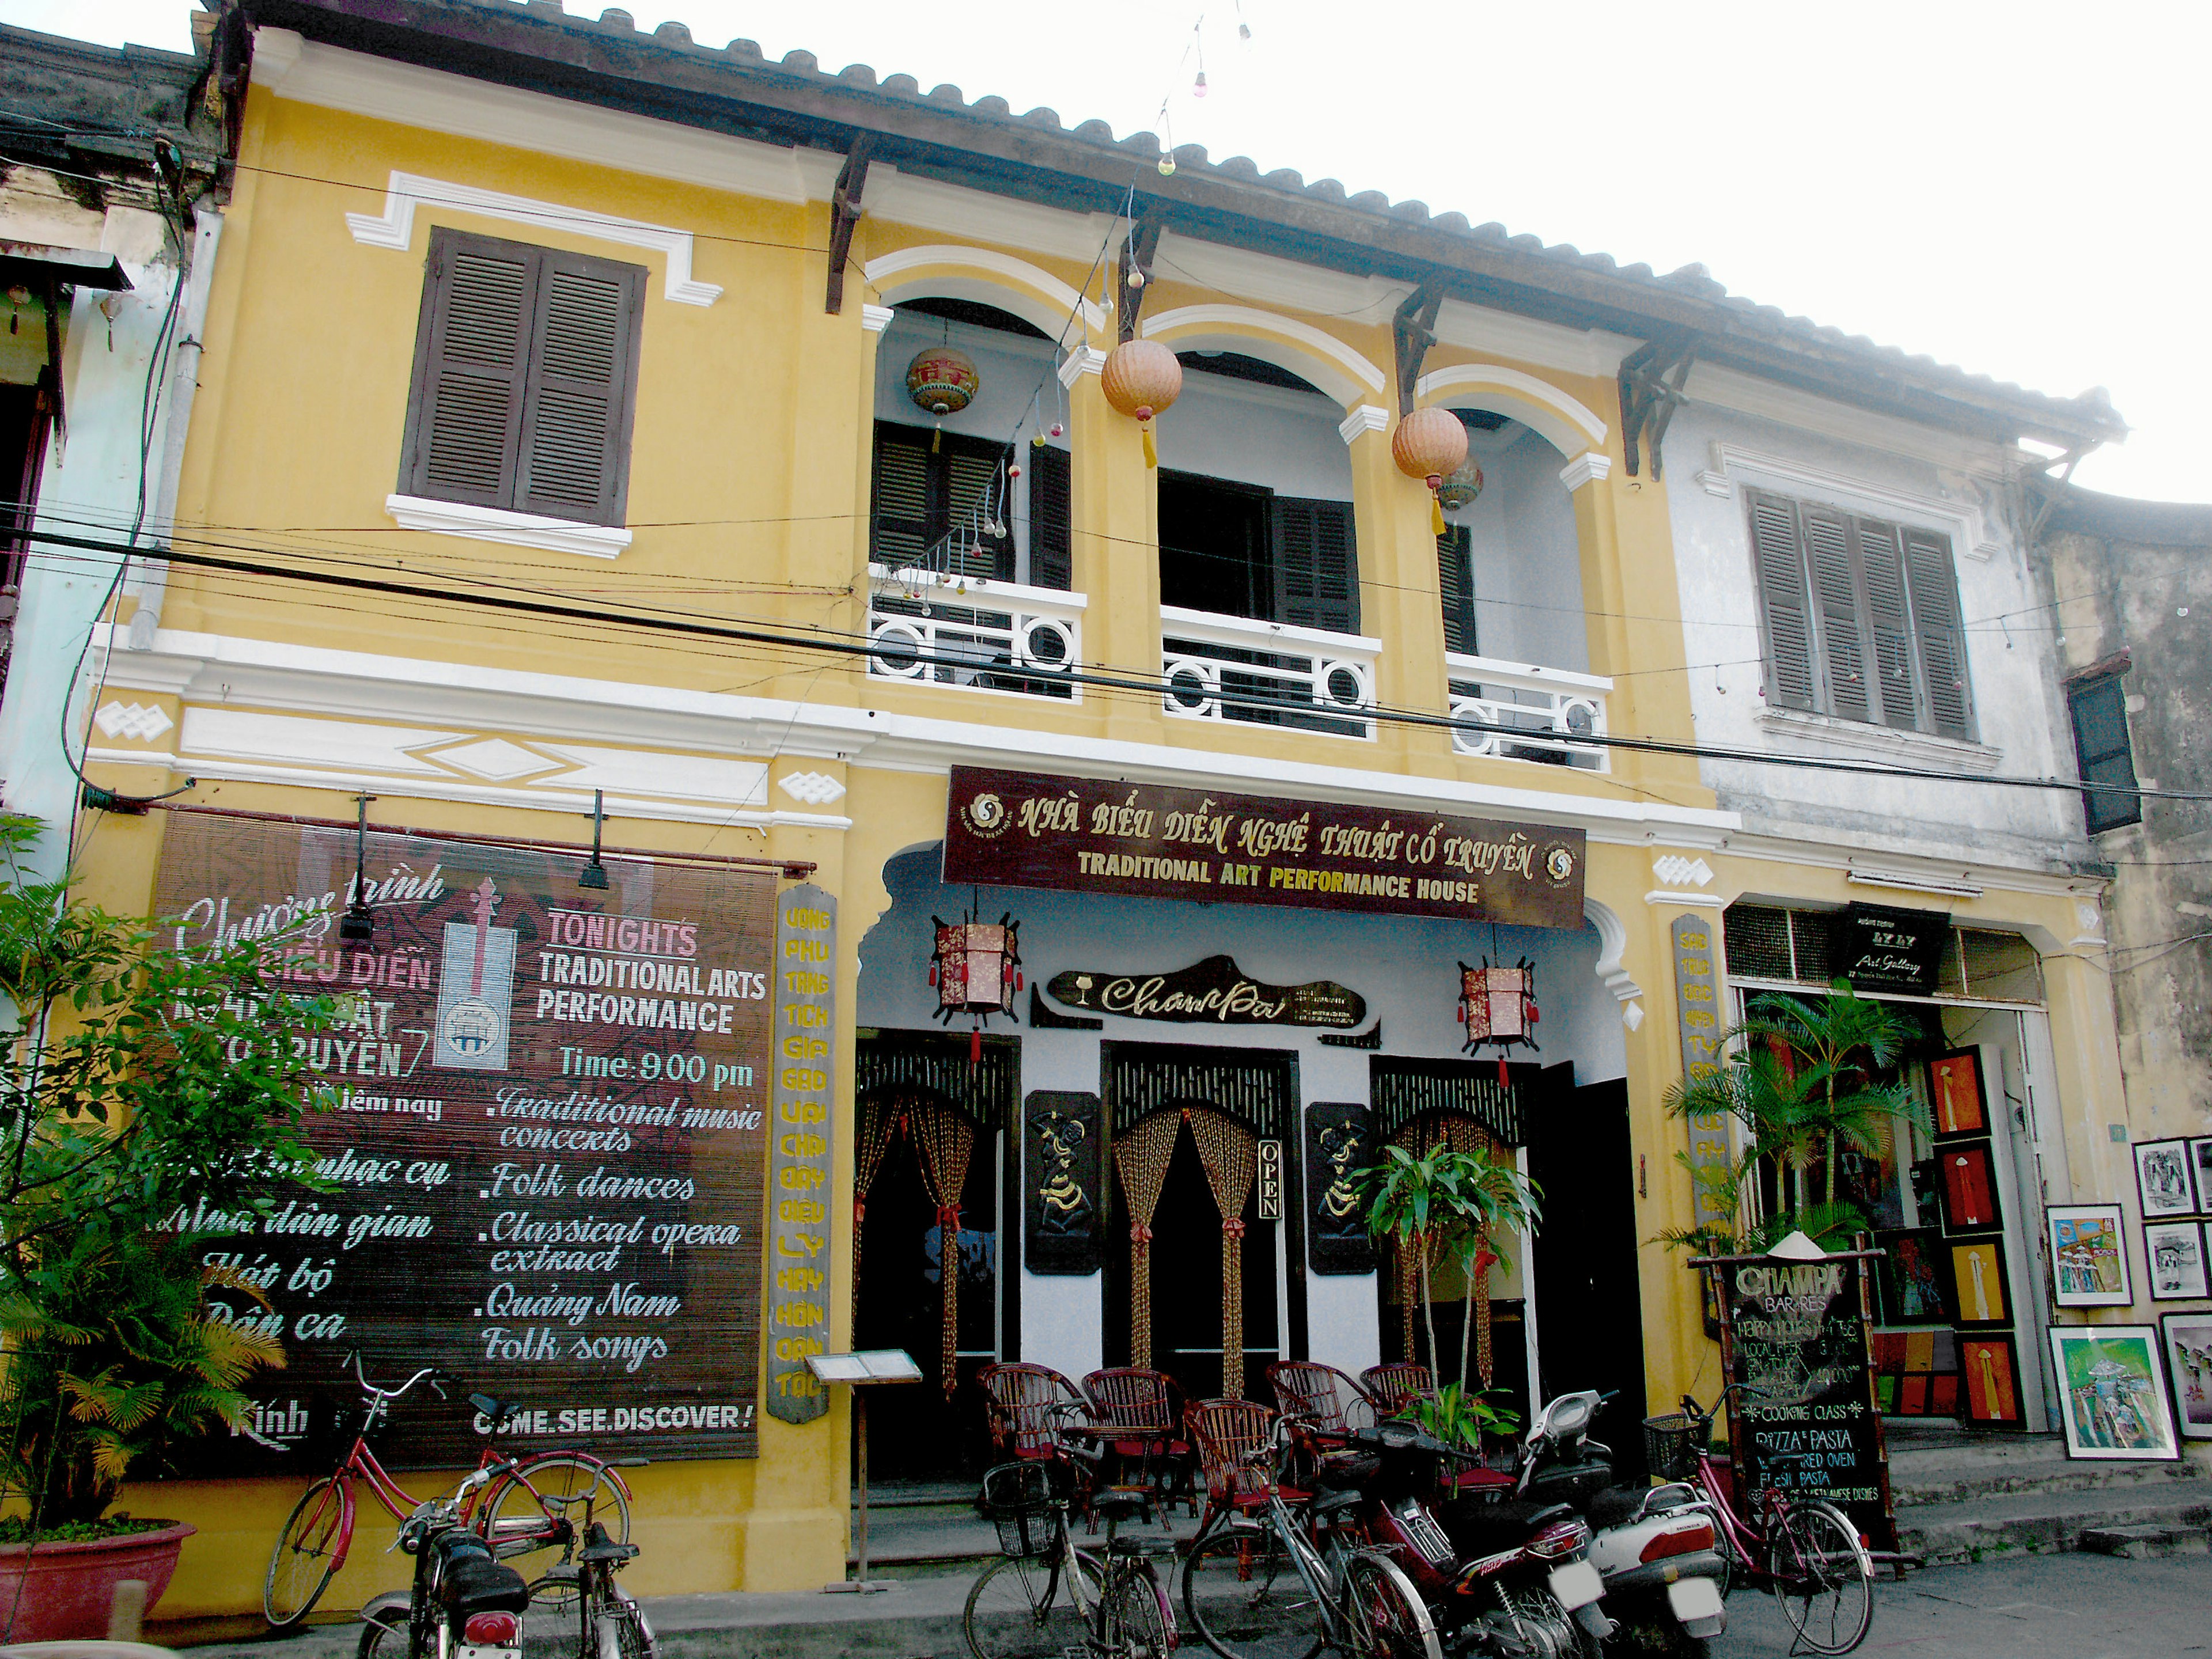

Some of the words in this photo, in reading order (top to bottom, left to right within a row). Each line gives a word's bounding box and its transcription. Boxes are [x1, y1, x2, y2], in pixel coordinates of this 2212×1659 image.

[1018, 790, 1080, 837] NHÀ
[1090, 789, 1154, 839] BIỂU
[1162, 798, 1234, 854] DIỄN
[1237, 812, 1309, 857] NGHỆ
[1320, 820, 1404, 862] THUẬT
[1406, 822, 1445, 863] CỔ
[1443, 831, 1536, 880] TRUYỀN
[1078, 851, 1211, 883] TRADITIONAL
[1219, 862, 1261, 887] ART
[1269, 867, 1410, 898] PERFORMANCE
[1416, 878, 1479, 903] HOUSE
[351, 945, 431, 989] DIỄN
[539, 952, 705, 997] TRADITIONAL
[706, 971, 767, 1001] ARTS
[536, 989, 734, 1035] PERFORMANCE
[714, 1064, 753, 1091] pm
[395, 1097, 442, 1122] nay
[496, 1086, 684, 1127] Traditional
[680, 1104, 762, 1130] music
[500, 1126, 632, 1153] concerts
[405, 1160, 450, 1191] cụ
[492, 1162, 567, 1198] Folk
[575, 1166, 695, 1200] dances
[1262, 1143, 1278, 1217] OPEN
[343, 1205, 433, 1251] gian
[491, 1210, 645, 1244] Classical
[651, 1222, 741, 1253] opera
[490, 1245, 620, 1272] extract
[777, 1266, 824, 1292] HAY
[1736, 1264, 1842, 1296] CHAMPA
[486, 1282, 595, 1325] Quảng
[596, 1282, 681, 1318] Nam
[295, 1313, 347, 1341] ca
[481, 1327, 560, 1361] Folk
[567, 1335, 669, 1373] songs
[1762, 1406, 1810, 1422] COOKING
[1815, 1404, 1847, 1421] CLASS
[1810, 1429, 1853, 1450] PASTA
[1827, 1452, 1855, 1467] OVEN
[1800, 1471, 1832, 1487] PASTA
